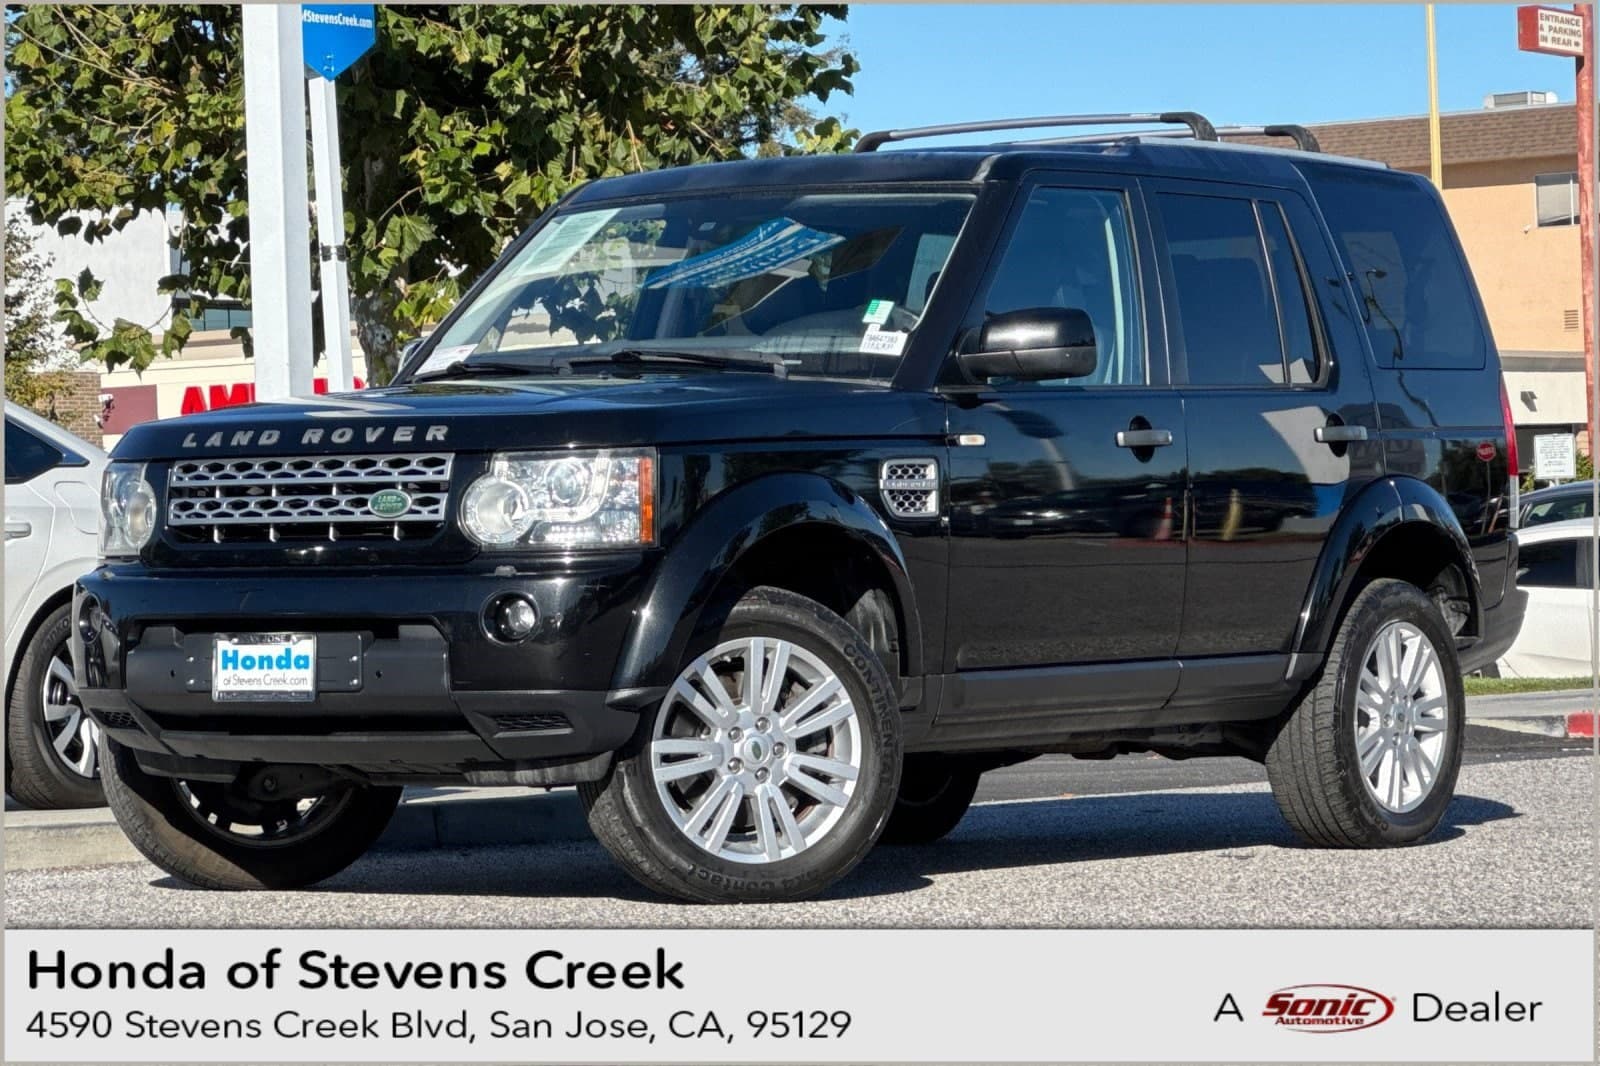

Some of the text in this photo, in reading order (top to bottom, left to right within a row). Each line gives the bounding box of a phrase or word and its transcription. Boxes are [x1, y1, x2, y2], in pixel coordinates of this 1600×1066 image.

[301, 9, 373, 29] fStevensCreek.com
[1539, 12, 1581, 27] ENTRANCE
[1539, 23, 1582, 38] & PARKING
[1540, 35, 1572, 47] IN REAR
[182, 424, 449, 448] LAND ROVER
[221, 647, 310, 670] Honda
[843, 642, 894, 785] CONTINENTAL
